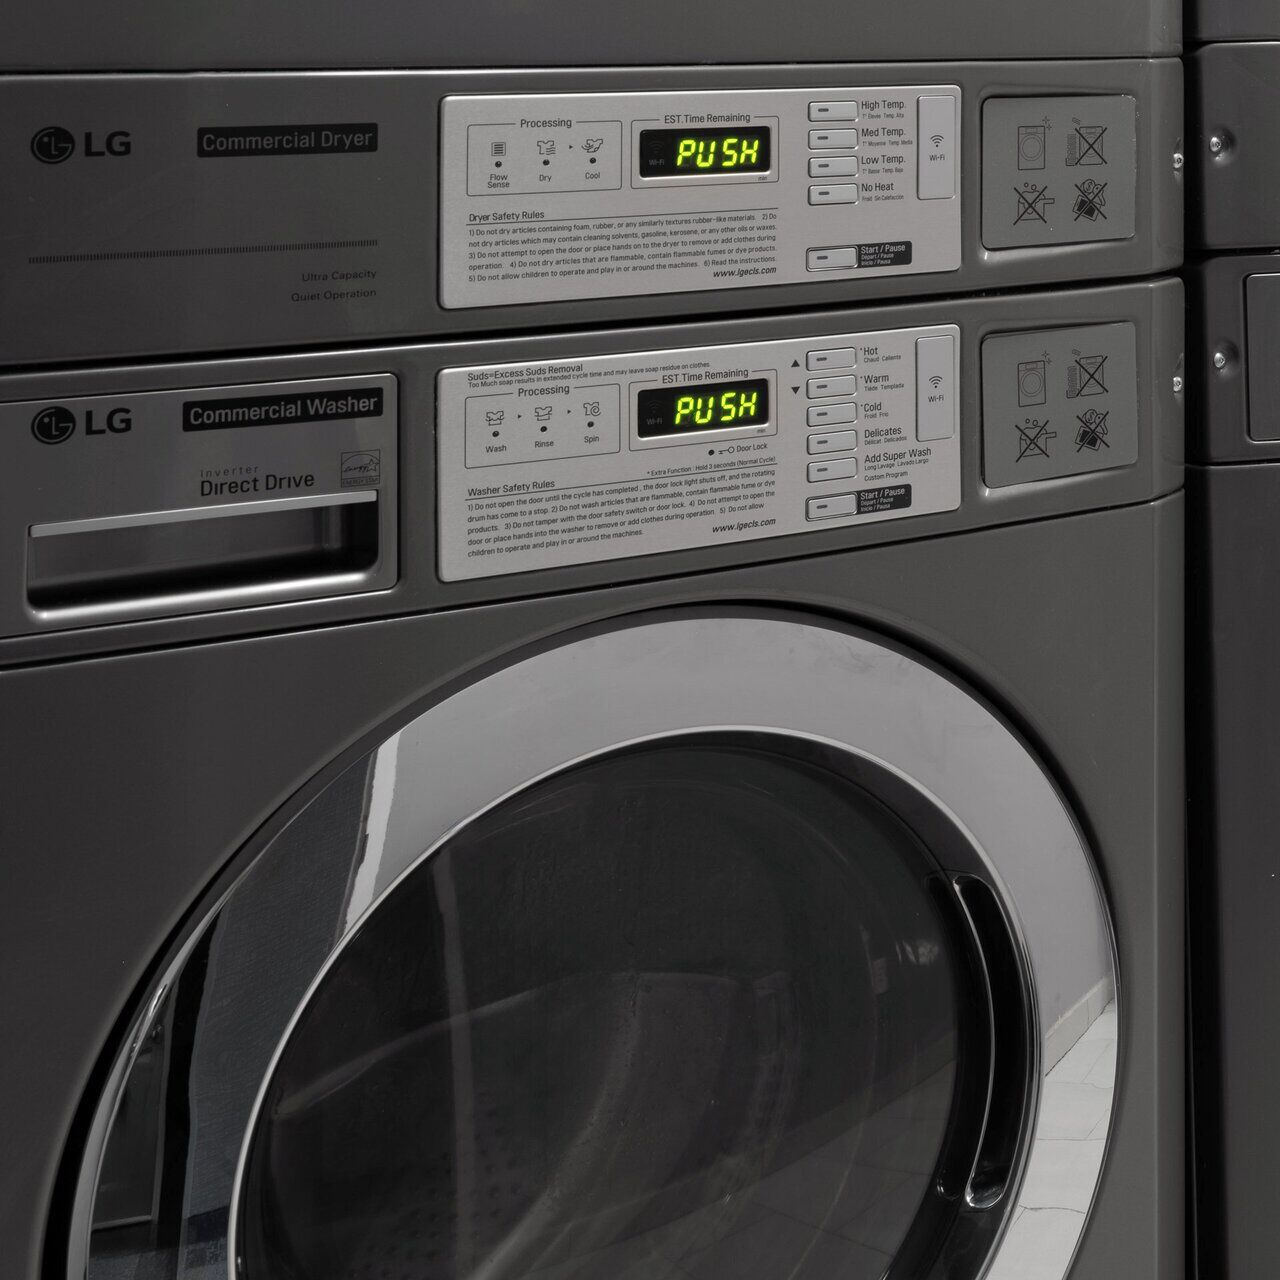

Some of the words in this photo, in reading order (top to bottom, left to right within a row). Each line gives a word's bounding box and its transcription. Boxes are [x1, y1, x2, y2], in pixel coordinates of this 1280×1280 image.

[861, 101, 879, 111] High
[706, 112, 750, 123] Remaining
[520, 118, 571, 129] Processing
[861, 128, 878, 136] Med
[84, 130, 130, 157] LG
[203, 131, 314, 150] Commercial
[321, 130, 372, 150] Dryer
[677, 138, 758, 167] PUSH
[861, 155, 879, 164] Low
[489, 173, 507, 181] Flow
[539, 174, 551, 182] Dry
[585, 171, 600, 179] Cool
[487, 180, 509, 188] Sense
[861, 183, 872, 191] No
[875, 182, 893, 191] Heat
[469, 213, 490, 223] Dryer
[492, 212, 520, 222] Safety
[522, 210, 544, 219] Rules
[468, 251, 475, 259] 3)
[500, 249, 527, 258] attempt
[537, 248, 554, 256] open
[568, 245, 582, 253] door
[593, 244, 610, 252] place
[662, 240, 679, 248] dryer
[733, 235, 755, 243] clothes
[756, 234, 775, 242] during
[861, 245, 878, 253] Start
[885, 244, 905, 252] Pause
[302, 271, 328, 282] Ultra
[331, 268, 376, 281] Capacity
[291, 291, 322, 304] Quiet
[323, 287, 376, 301] Operation
[863, 346, 877, 355] Hot
[525, 366, 546, 376] Suds
[548, 364, 583, 375] Removal
[704, 368, 748, 382] Remaining
[864, 374, 888, 383] Warm
[518, 384, 569, 397] Processing
[928, 394, 943, 402] Wi-Fi
[190, 400, 300, 424] Commercial
[307, 395, 377, 415] Washer
[675, 391, 756, 424] PUSH
[863, 402, 881, 412] Cold
[85, 407, 131, 435] LG
[864, 427, 901, 438] Delicates
[534, 439, 553, 447] Rinse
[584, 434, 599, 444] Spin
[485, 444, 506, 452] Wash
[736, 444, 751, 452] Door
[753, 442, 767, 450] Lock
[864, 453, 881, 463] Add
[883, 450, 906, 462] Super
[908, 448, 931, 457] Wash
[864, 473, 884, 481] Custom
[885, 471, 908, 479] Program
[200, 477, 258, 496] Direct
[265, 472, 314, 490] Drive
[467, 485, 500, 496] Washer
[502, 482, 531, 494] Safety
[532, 479, 555, 491] Rules
[860, 490, 877, 499] Start
[884, 488, 904, 496] Pause
